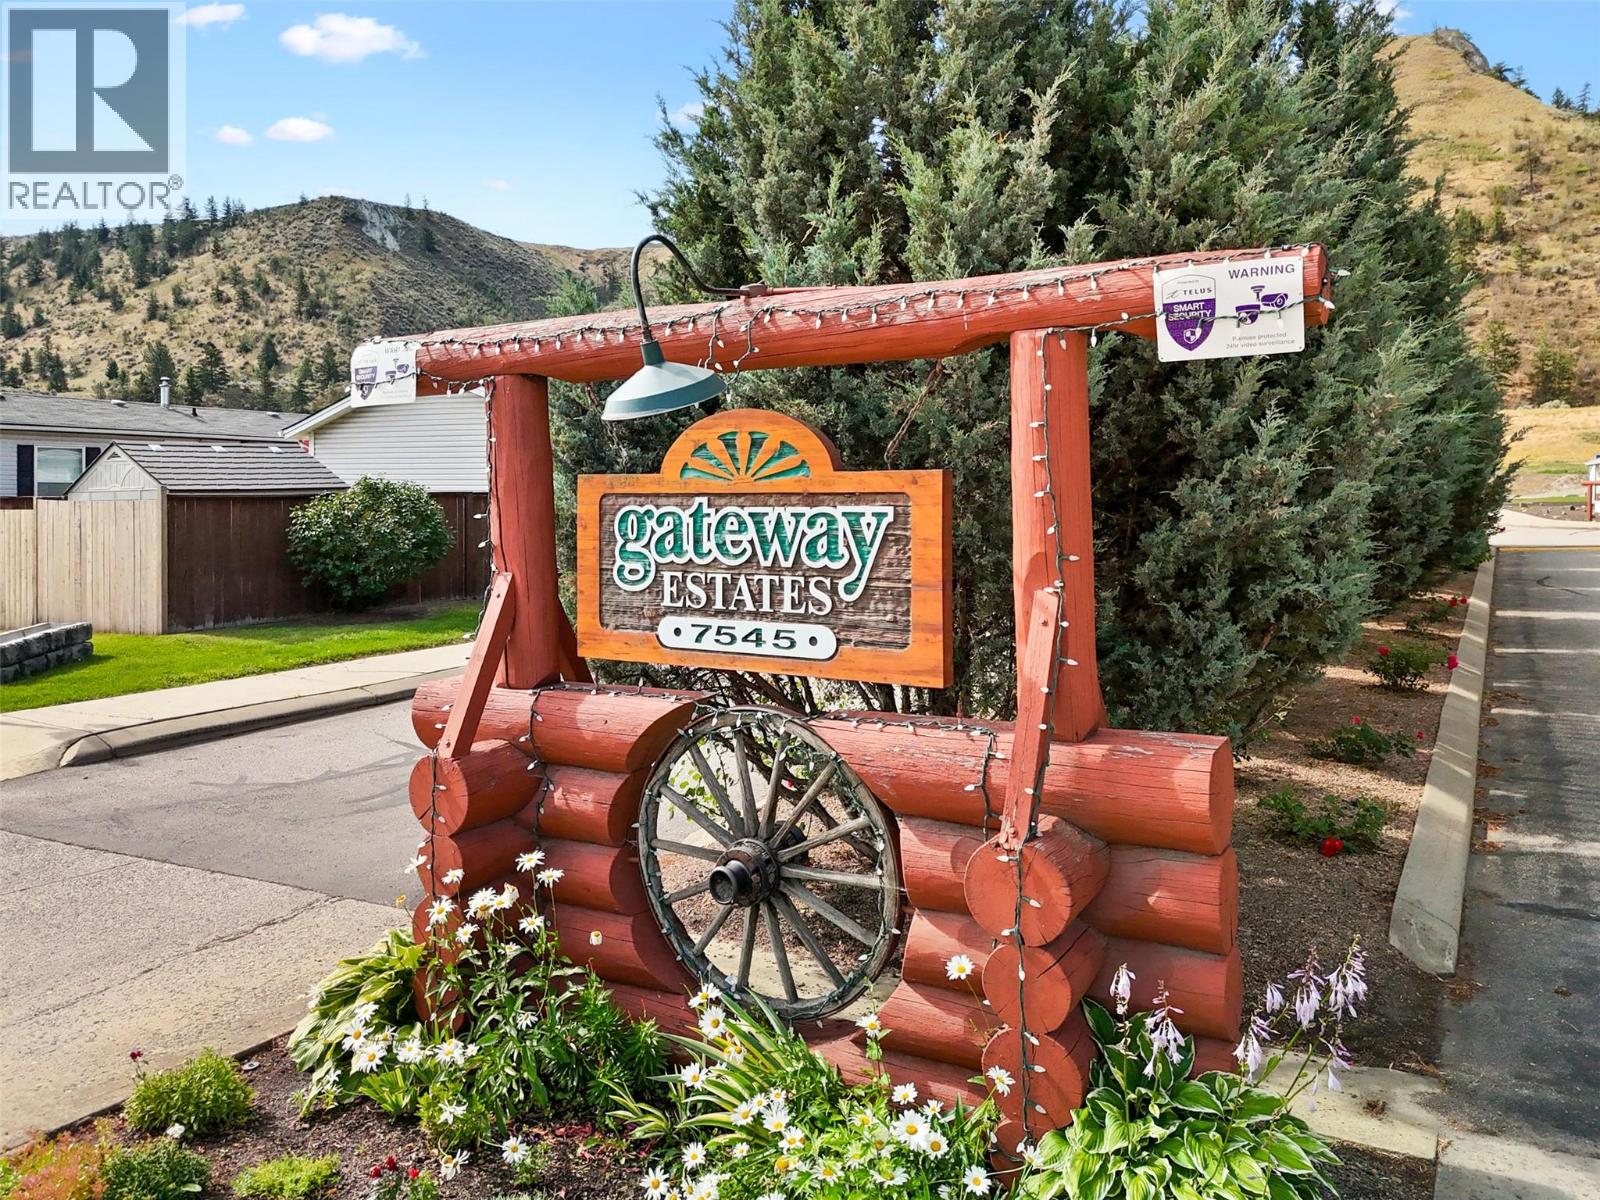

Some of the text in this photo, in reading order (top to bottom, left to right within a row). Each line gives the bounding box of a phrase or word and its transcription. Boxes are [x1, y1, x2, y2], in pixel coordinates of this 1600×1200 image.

[1228, 263, 1296, 280] WARNING
[1183, 287, 1213, 296] TELUS
[1173, 301, 1205, 313] SMART
[613, 497, 894, 602] gateway
[660, 571, 833, 617] ESTATES
[690, 623, 798, 651] 7545
